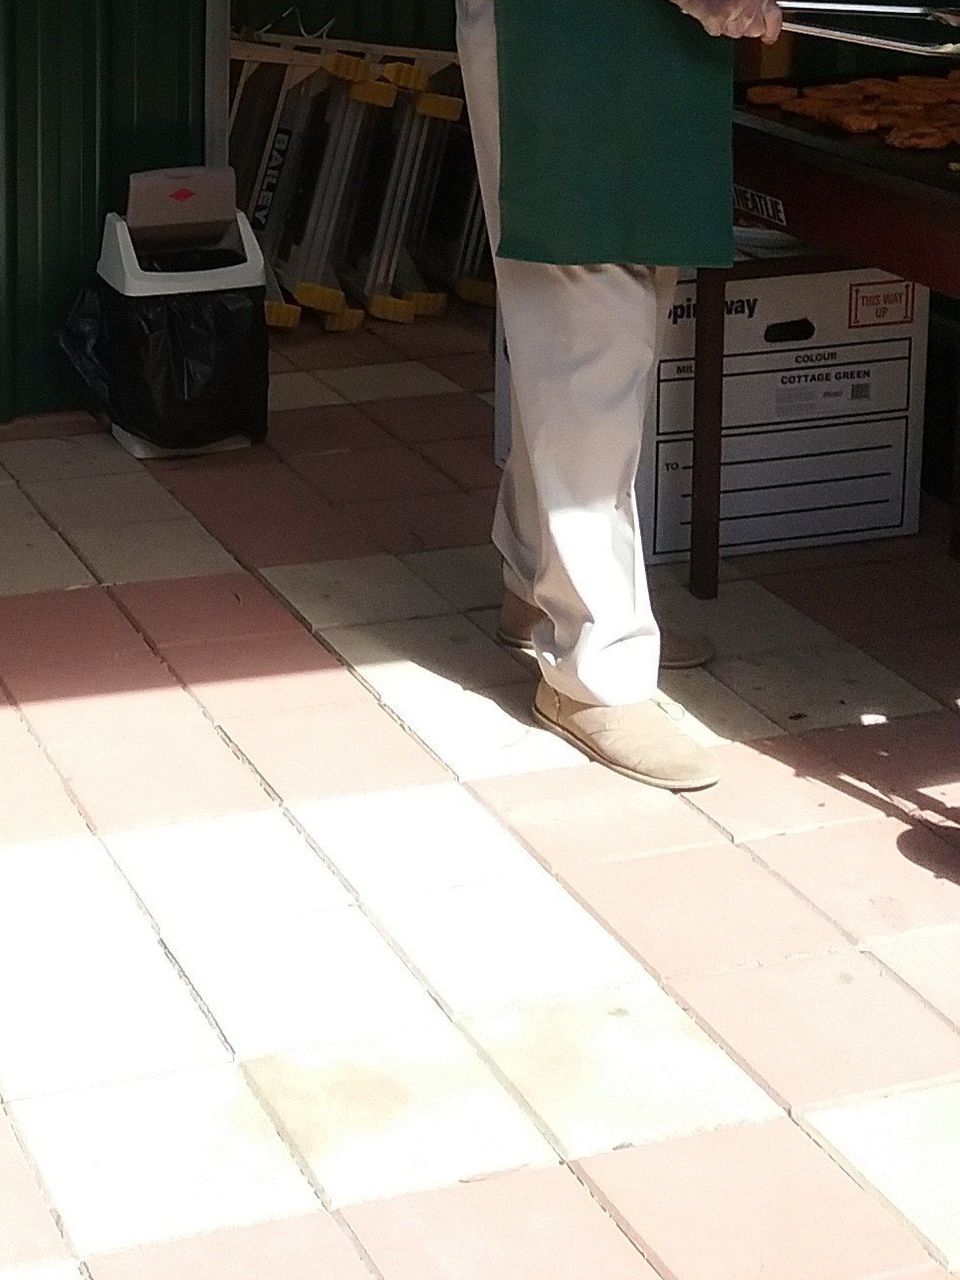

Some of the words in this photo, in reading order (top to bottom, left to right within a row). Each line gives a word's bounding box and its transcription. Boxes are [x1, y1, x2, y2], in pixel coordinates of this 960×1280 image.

[254, 132, 289, 225] BAILEY
[861, 295, 881, 307] THIS
[882, 292, 903, 305] WAY
[874, 306, 888, 319] UP
[794, 352, 838, 364] COLOUR
[780, 372, 831, 385] COTTAGE
[834, 369, 871, 381] GREEN
[665, 462, 679, 472] TO
